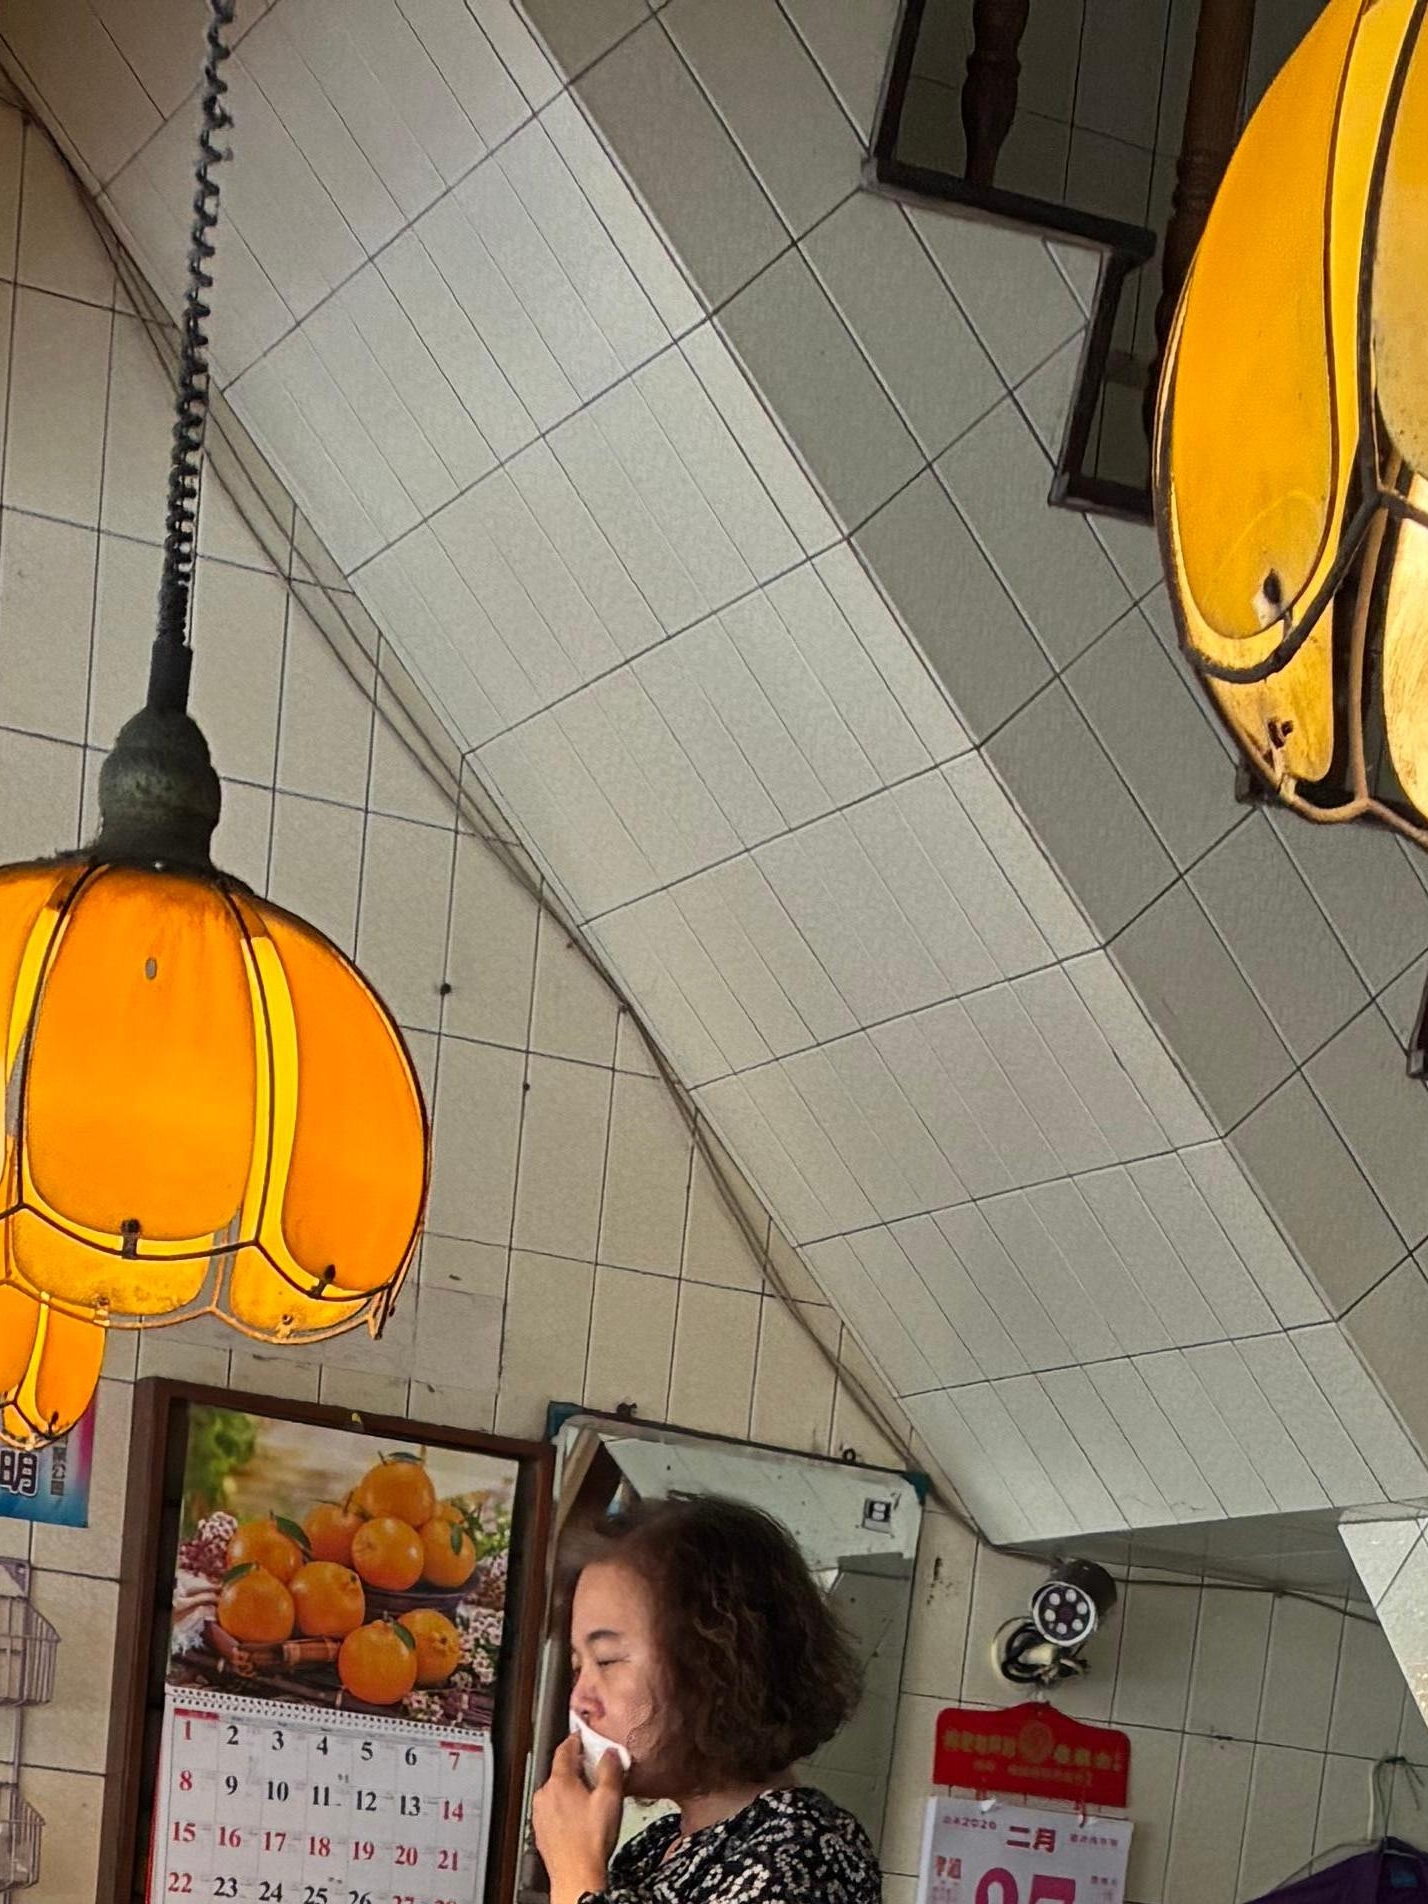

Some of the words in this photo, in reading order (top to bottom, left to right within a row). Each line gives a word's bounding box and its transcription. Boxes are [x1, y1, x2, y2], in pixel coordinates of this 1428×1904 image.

[182, 1720, 192, 1741] 1
[226, 1725, 239, 1745] 2
[272, 1731, 284, 1751] 3
[316, 1736, 329, 1755] 4
[360, 1742, 373, 1761] 5
[404, 1747, 417, 1766] 6
[449, 1752, 460, 1771] 7
[179, 1770, 192, 1791] 8
[226, 1775, 238, 1795] 9
[267, 1781, 289, 1801] 10
[312, 1786, 330, 1806] 11
[356, 1791, 376, 1811] 12
[399, 1796, 421, 1816] 13
[442, 1800, 463, 1822] 14
[172, 1822, 195, 1842] 15
[218, 1826, 241, 1848] 16
[263, 1831, 286, 1852] 17
[308, 1836, 330, 1857] 18
[352, 1841, 374, 1861] 19
[394, 1845, 418, 1866] 20
[437, 1850, 458, 1870] 21
[1006, 1825, 1056, 1853] 二月
[168, 1873, 192, 1893] 22
[213, 1877, 238, 1897] 23
[258, 1882, 283, 1902] 24
